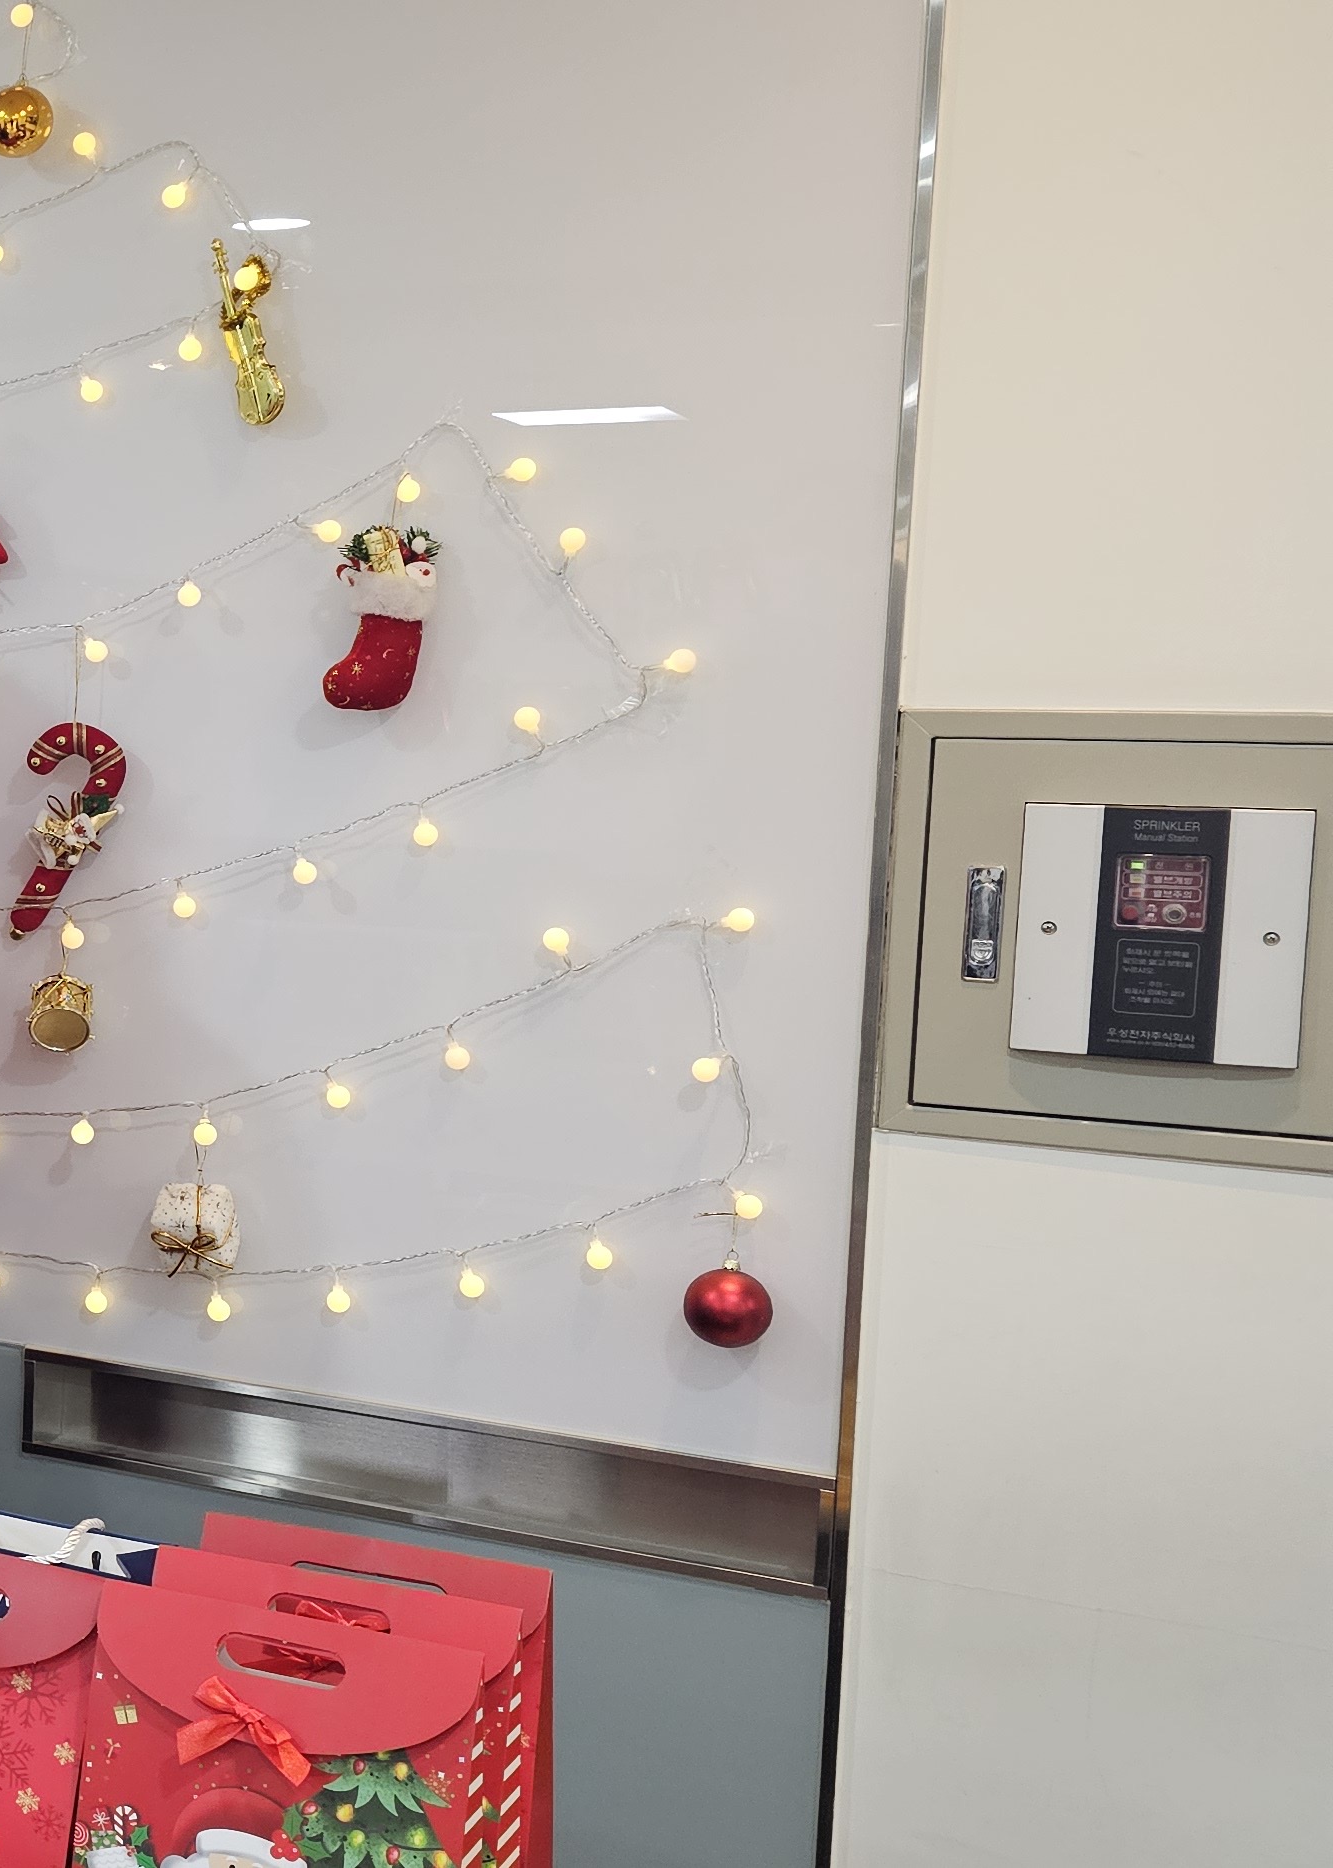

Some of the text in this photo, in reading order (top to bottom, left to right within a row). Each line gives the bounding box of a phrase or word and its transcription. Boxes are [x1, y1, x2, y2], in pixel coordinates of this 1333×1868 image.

[1133, 819, 1201, 832] SPRINKLER
[1134, 833, 1199, 843] Manual Station
